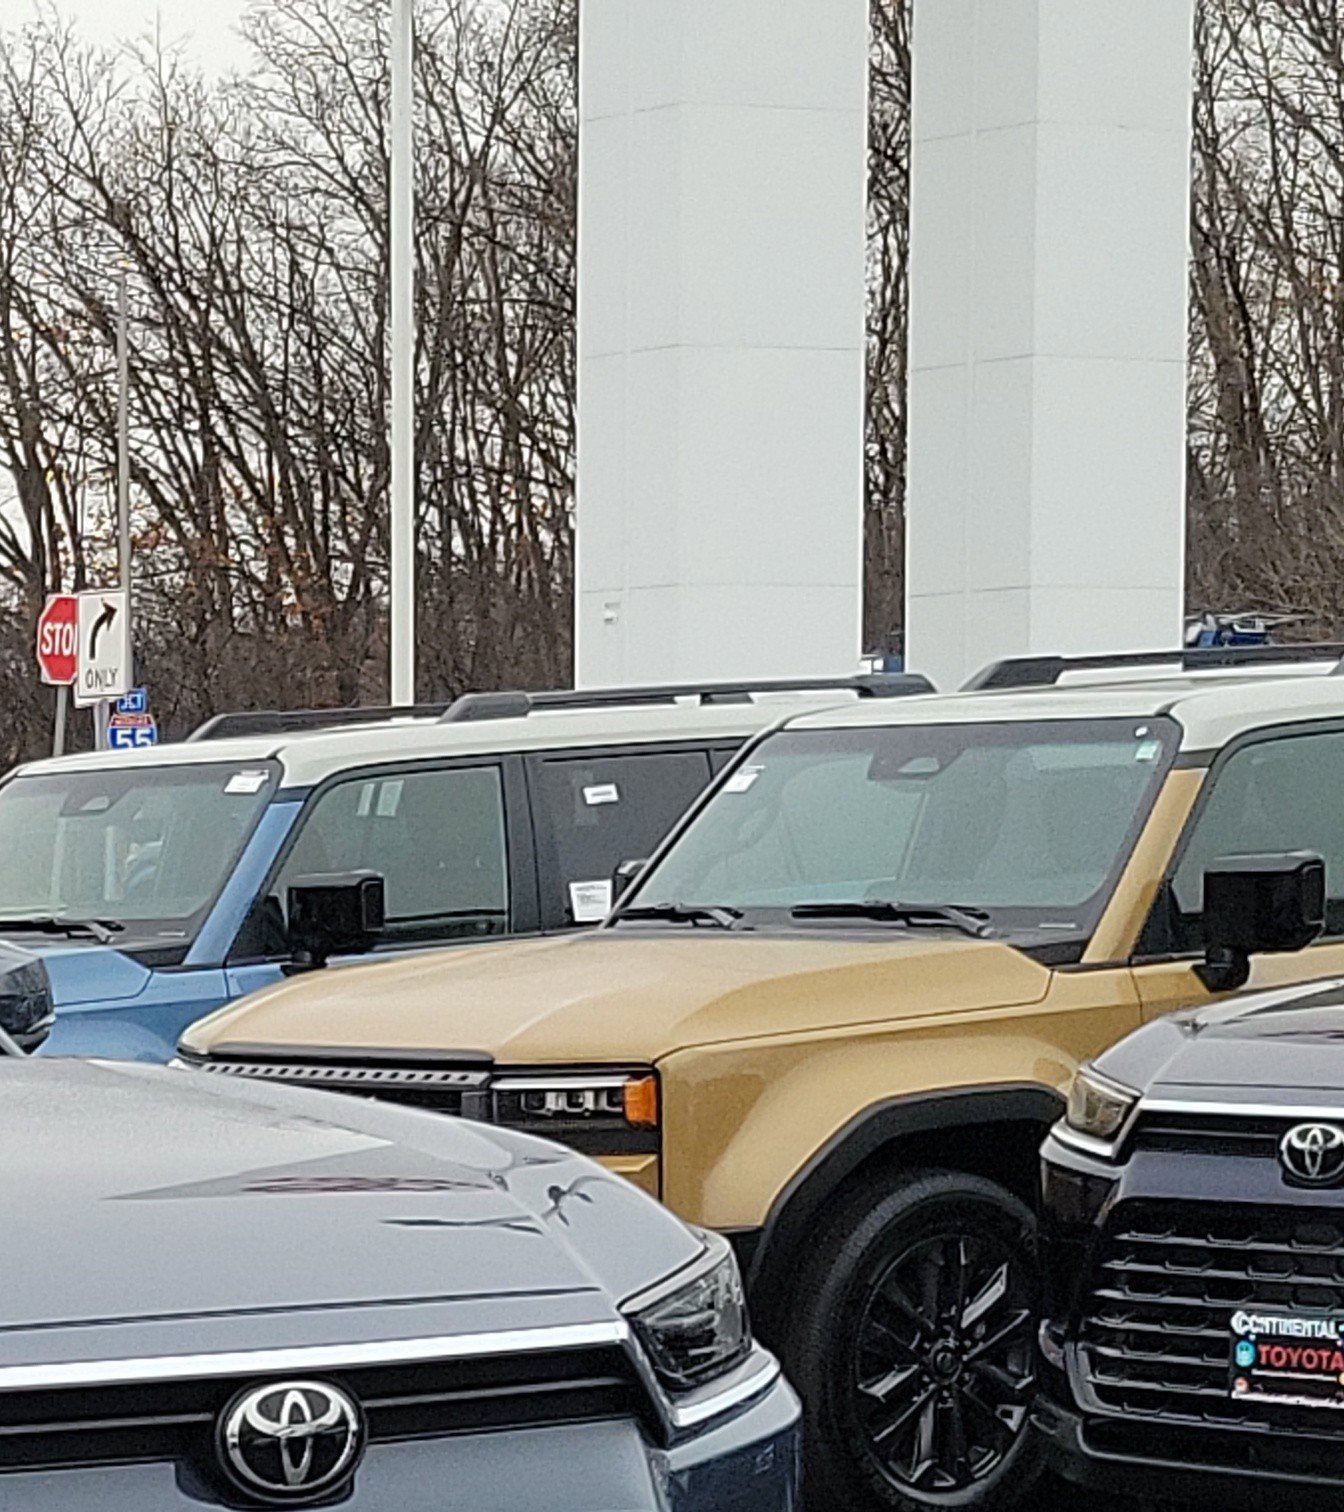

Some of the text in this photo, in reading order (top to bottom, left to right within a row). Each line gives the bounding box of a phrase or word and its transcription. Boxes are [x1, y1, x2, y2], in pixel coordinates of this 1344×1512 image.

[85, 668, 118, 690] ONLY
[116, 728, 153, 749] 55
[1257, 1344, 1344, 1371] TOYOTA
